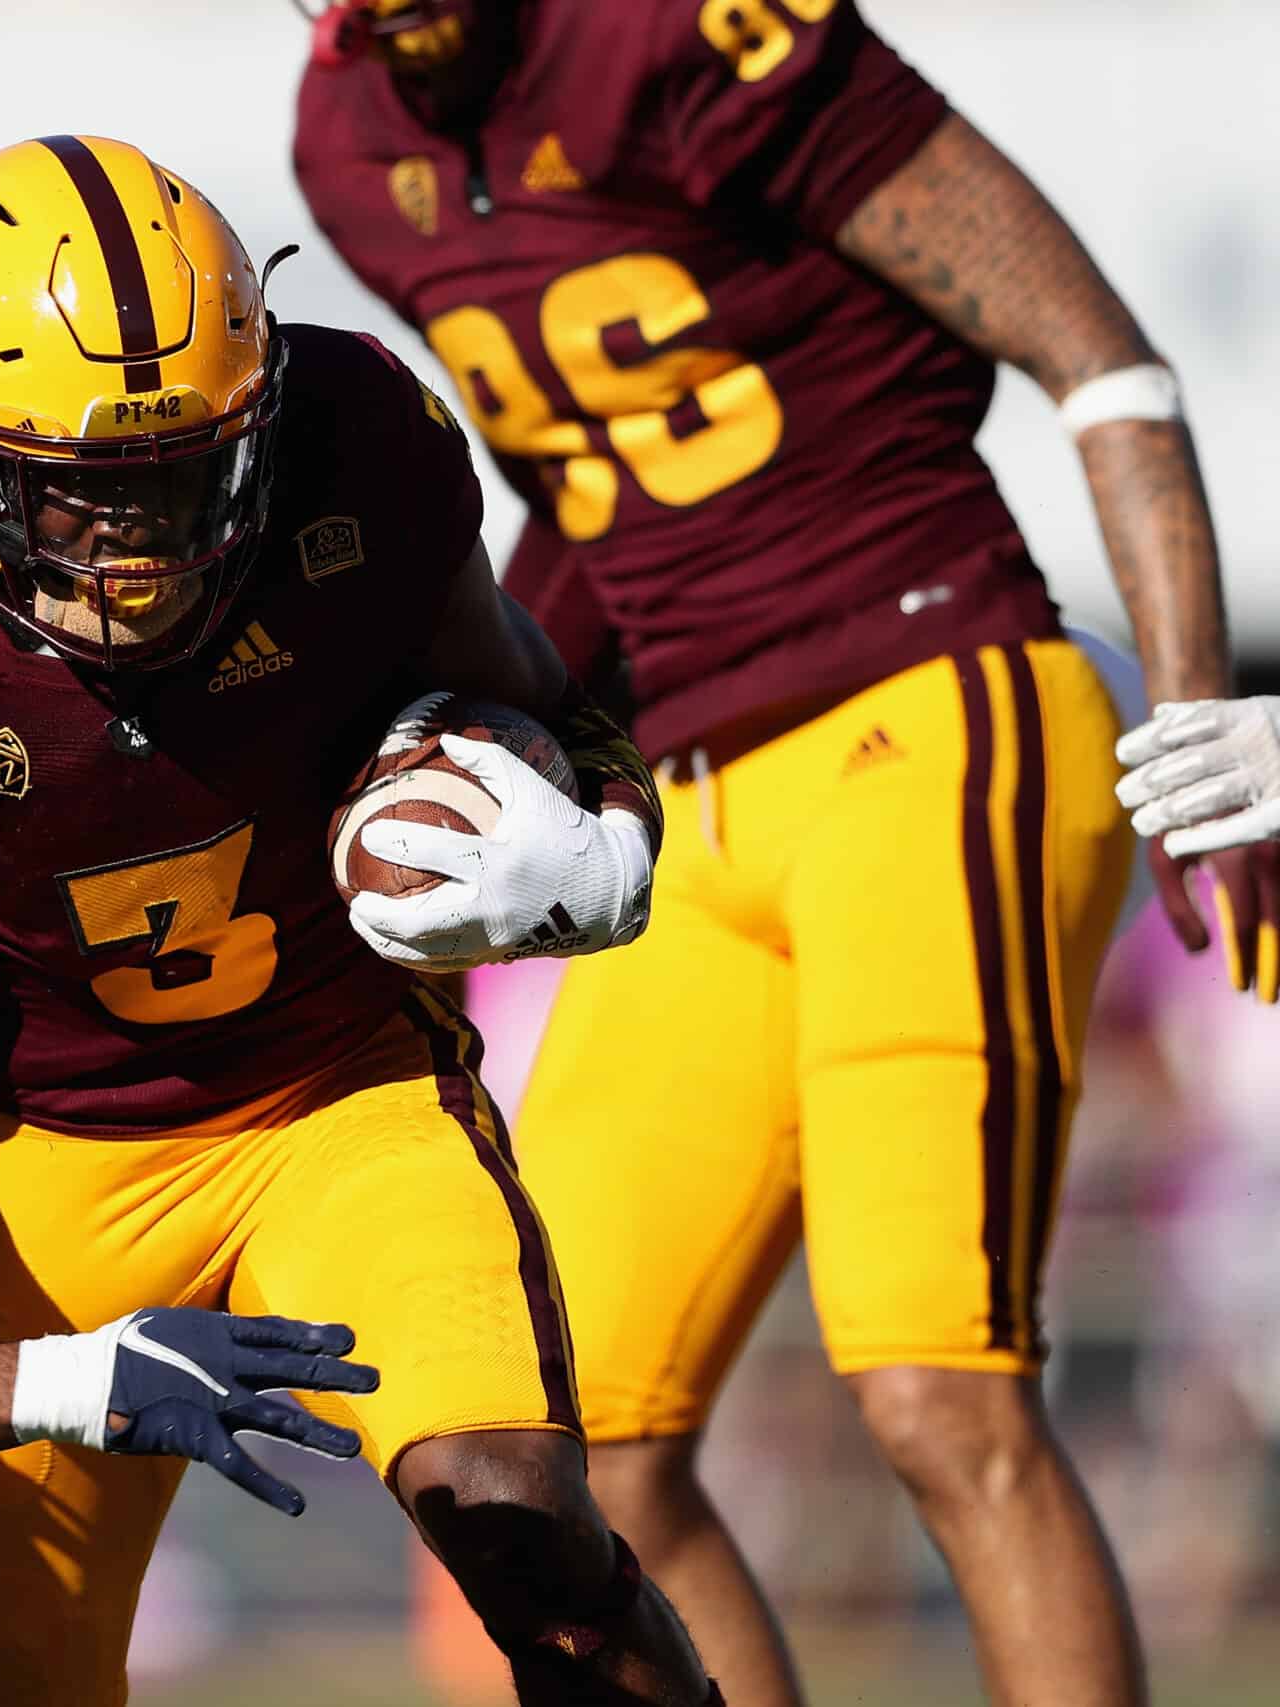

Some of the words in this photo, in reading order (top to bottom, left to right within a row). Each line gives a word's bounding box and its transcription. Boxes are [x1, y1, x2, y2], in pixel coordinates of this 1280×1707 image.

[207, 651, 295, 694] adidas
[55, 812, 279, 1025] 3
[503, 934, 592, 960] adidas
